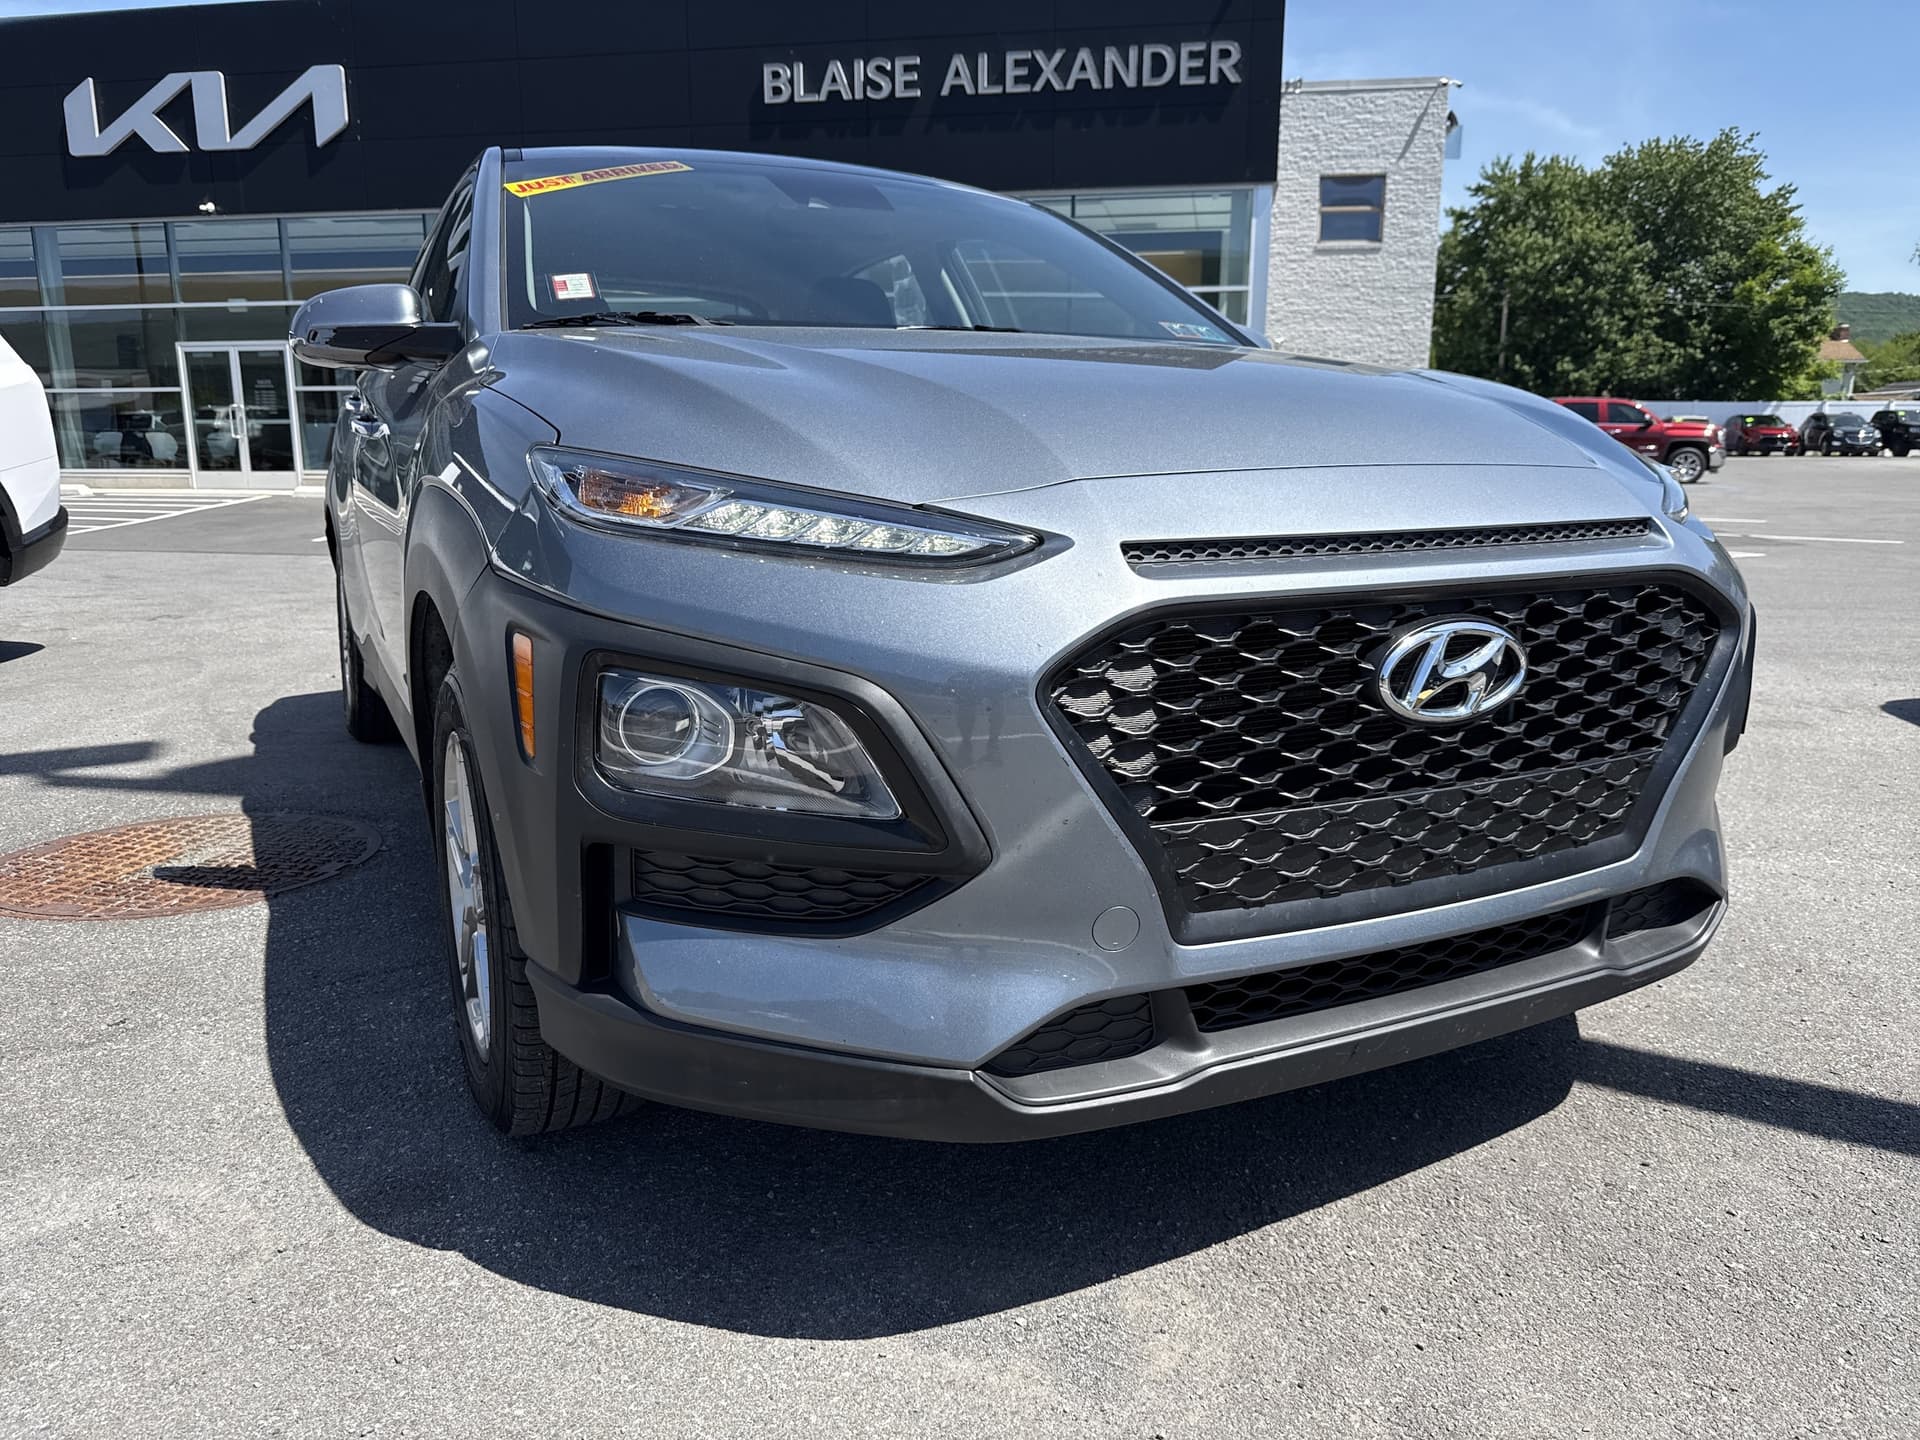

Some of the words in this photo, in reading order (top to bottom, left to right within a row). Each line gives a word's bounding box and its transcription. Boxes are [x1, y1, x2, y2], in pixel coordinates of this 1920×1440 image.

[763, 56, 921, 104] BLAISE
[940, 40, 1242, 96] ALEXANDER
[63, 63, 349, 157] KIA
[515, 175, 577, 193] JUST
